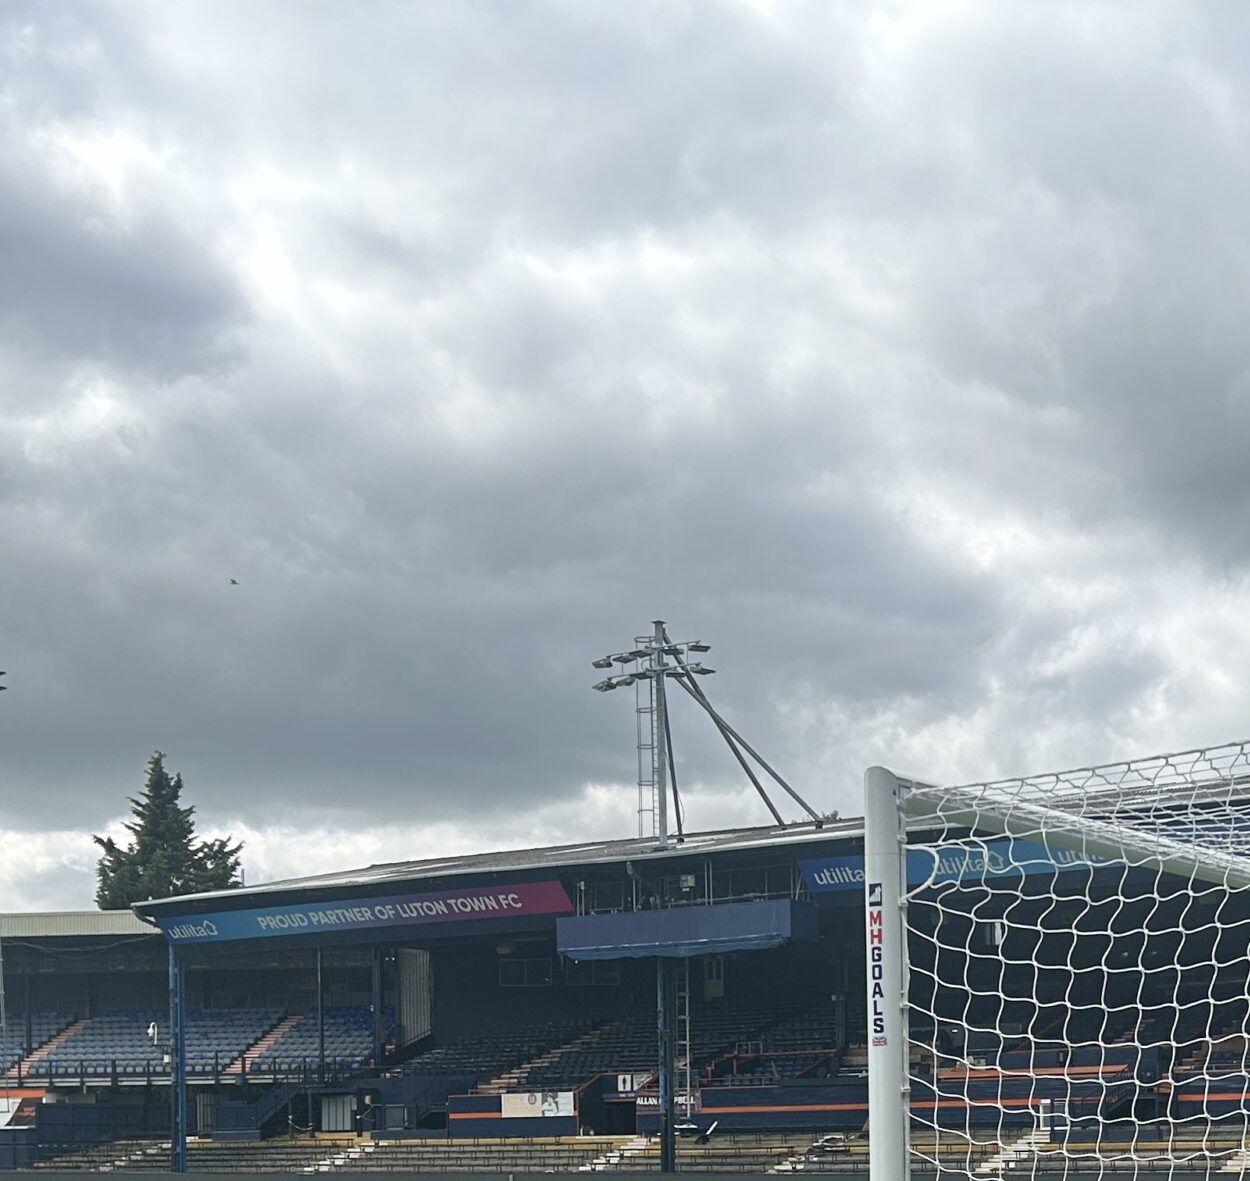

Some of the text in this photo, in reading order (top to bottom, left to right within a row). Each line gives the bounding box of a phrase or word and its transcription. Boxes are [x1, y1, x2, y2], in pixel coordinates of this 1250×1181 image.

[813, 863, 866, 886] utilita
[256, 893, 524, 931] PROUD PARTNER OF LUTON TOWN FC
[168, 922, 208, 940] utilita
